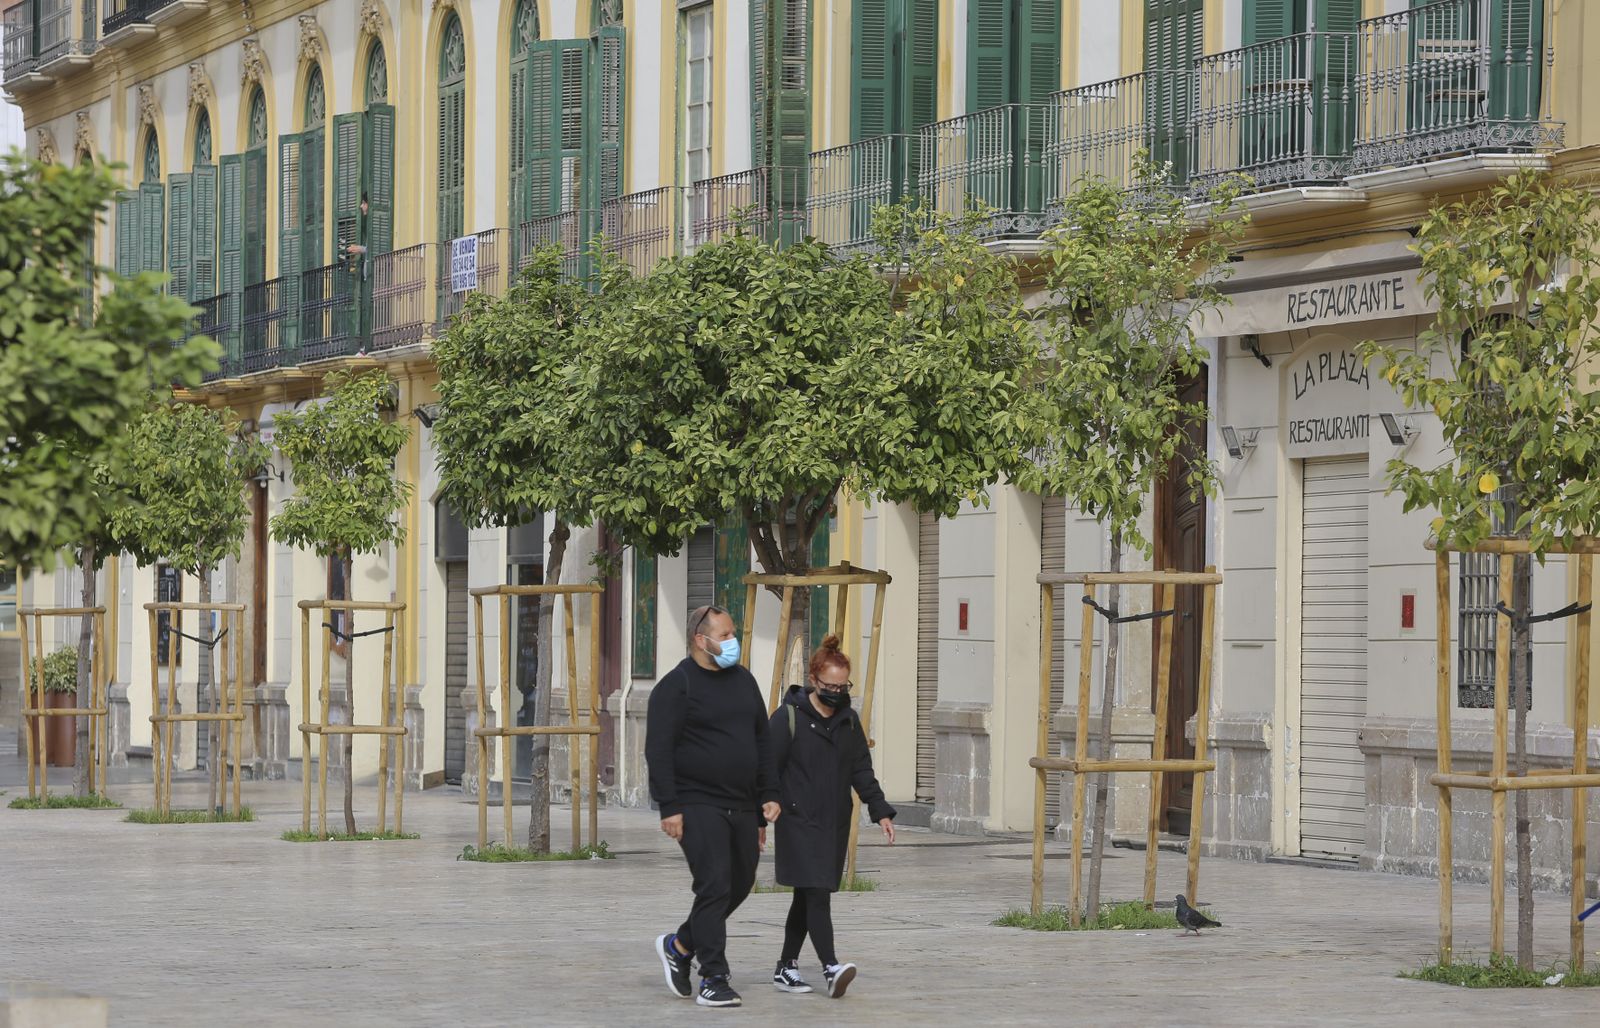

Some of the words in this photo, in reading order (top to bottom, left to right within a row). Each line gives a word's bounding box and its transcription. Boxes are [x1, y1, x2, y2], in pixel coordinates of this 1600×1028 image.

[459, 238, 476, 255] VENDE
[469, 255, 475, 270] 54
[1287, 277, 1405, 324] RESTAURANTE
[1293, 359, 1315, 400] LA
[1319, 350, 1370, 390] PLAZA
